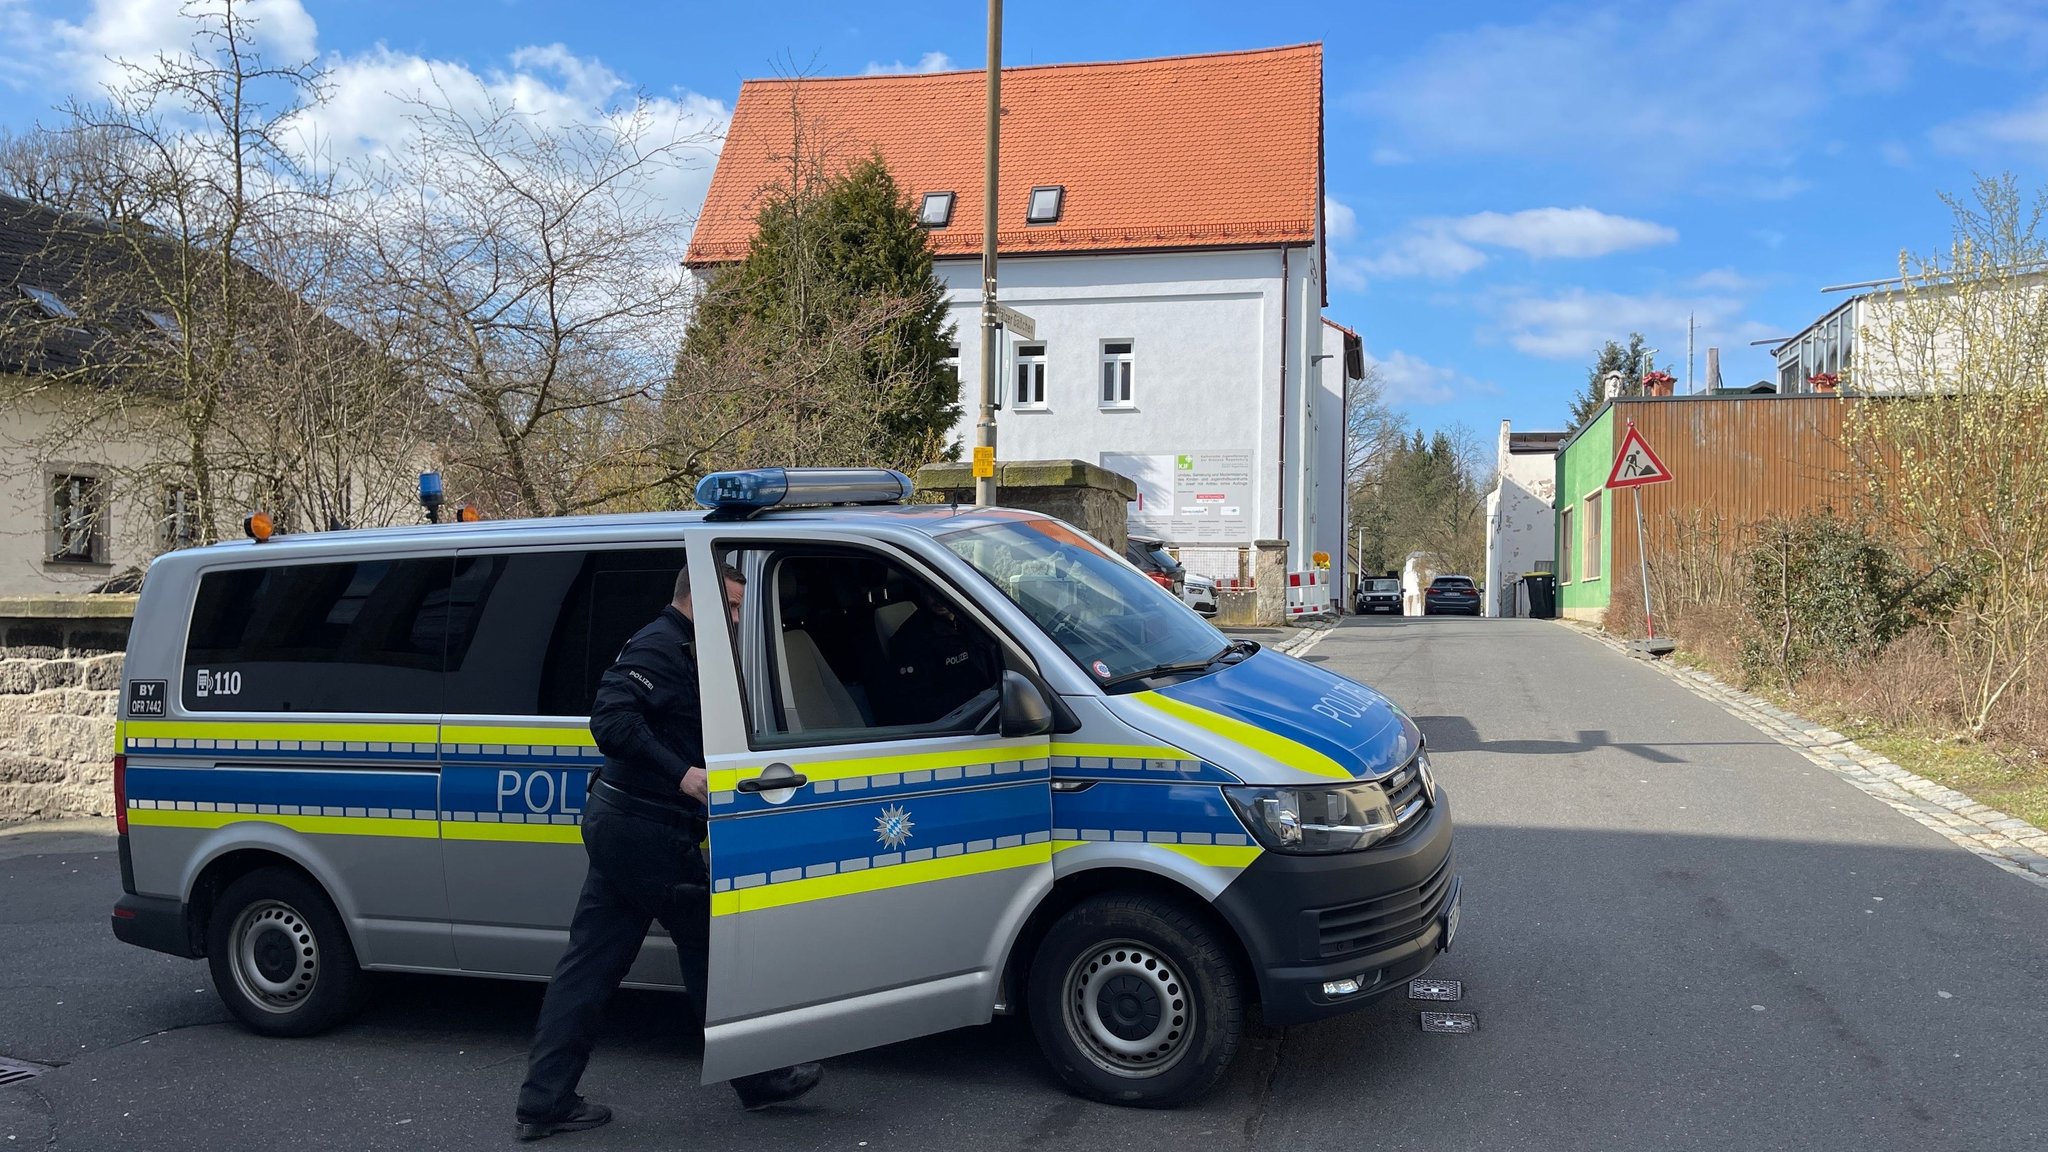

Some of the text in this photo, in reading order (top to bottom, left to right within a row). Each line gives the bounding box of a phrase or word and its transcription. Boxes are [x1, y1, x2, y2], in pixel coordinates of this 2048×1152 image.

[139, 684, 155, 696] BY
[214, 671, 242, 695] 110
[628, 670, 654, 691] POLIZEI
[131, 701, 162, 713] OFR 7442
[1311, 682, 1377, 728] POLIZE
